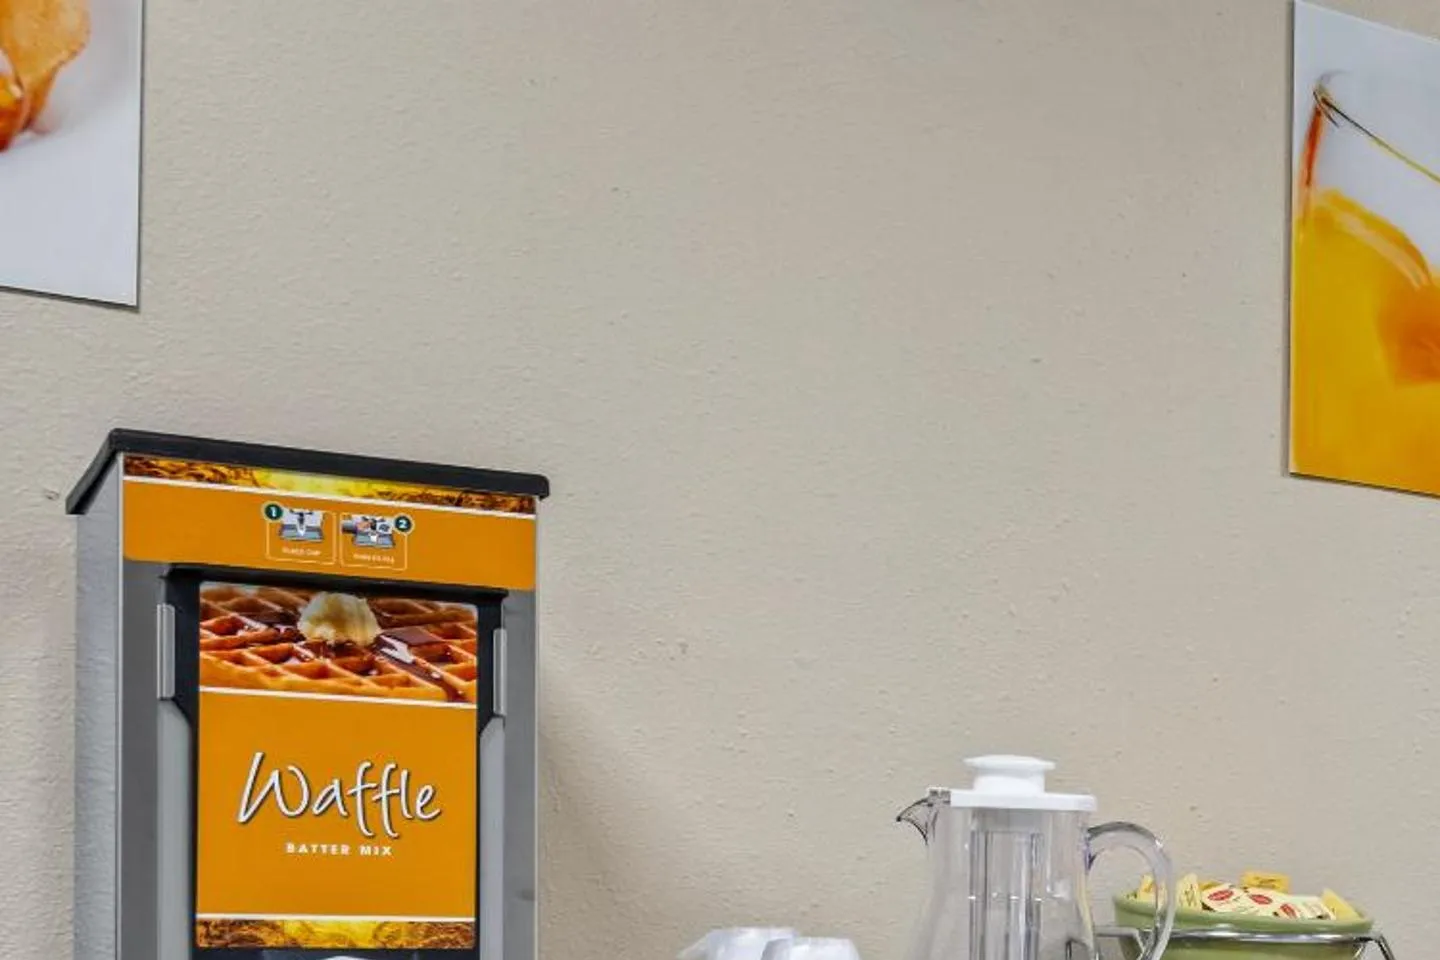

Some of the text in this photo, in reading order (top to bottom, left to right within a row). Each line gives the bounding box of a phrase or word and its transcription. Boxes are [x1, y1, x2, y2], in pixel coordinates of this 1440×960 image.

[237, 752, 442, 839] Waffle
[286, 842, 393, 857] BATTER MIX
